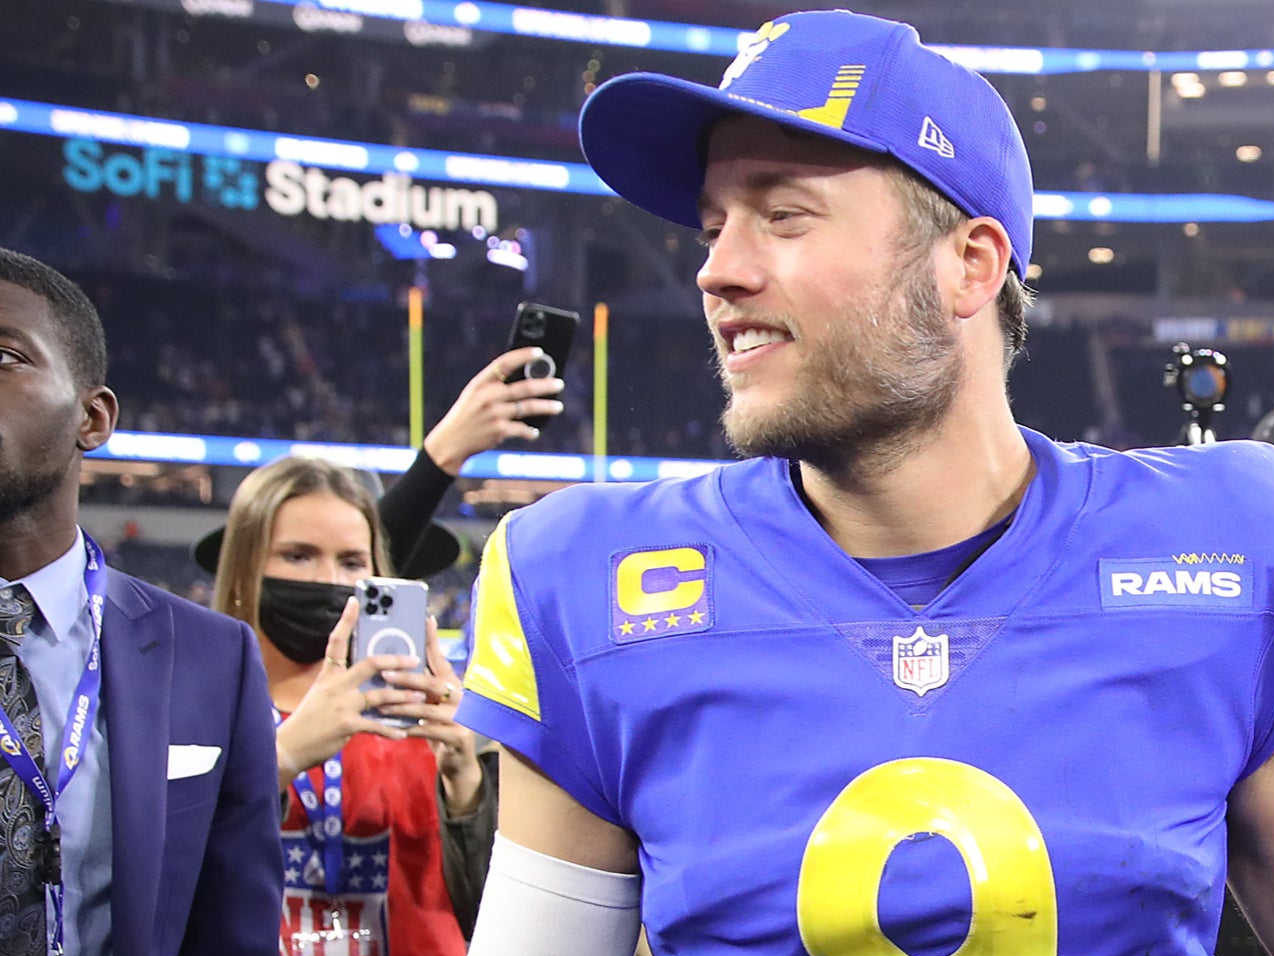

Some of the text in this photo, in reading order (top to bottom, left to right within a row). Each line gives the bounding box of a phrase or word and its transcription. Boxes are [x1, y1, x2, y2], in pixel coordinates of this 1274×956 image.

[63, 138, 193, 202] SoFi
[266, 160, 498, 232] Stadium
[616, 548, 704, 616] C
[1111, 570, 1242, 598] RAMS
[903, 658, 938, 681] NFL
[70, 694, 90, 747] RAMS
